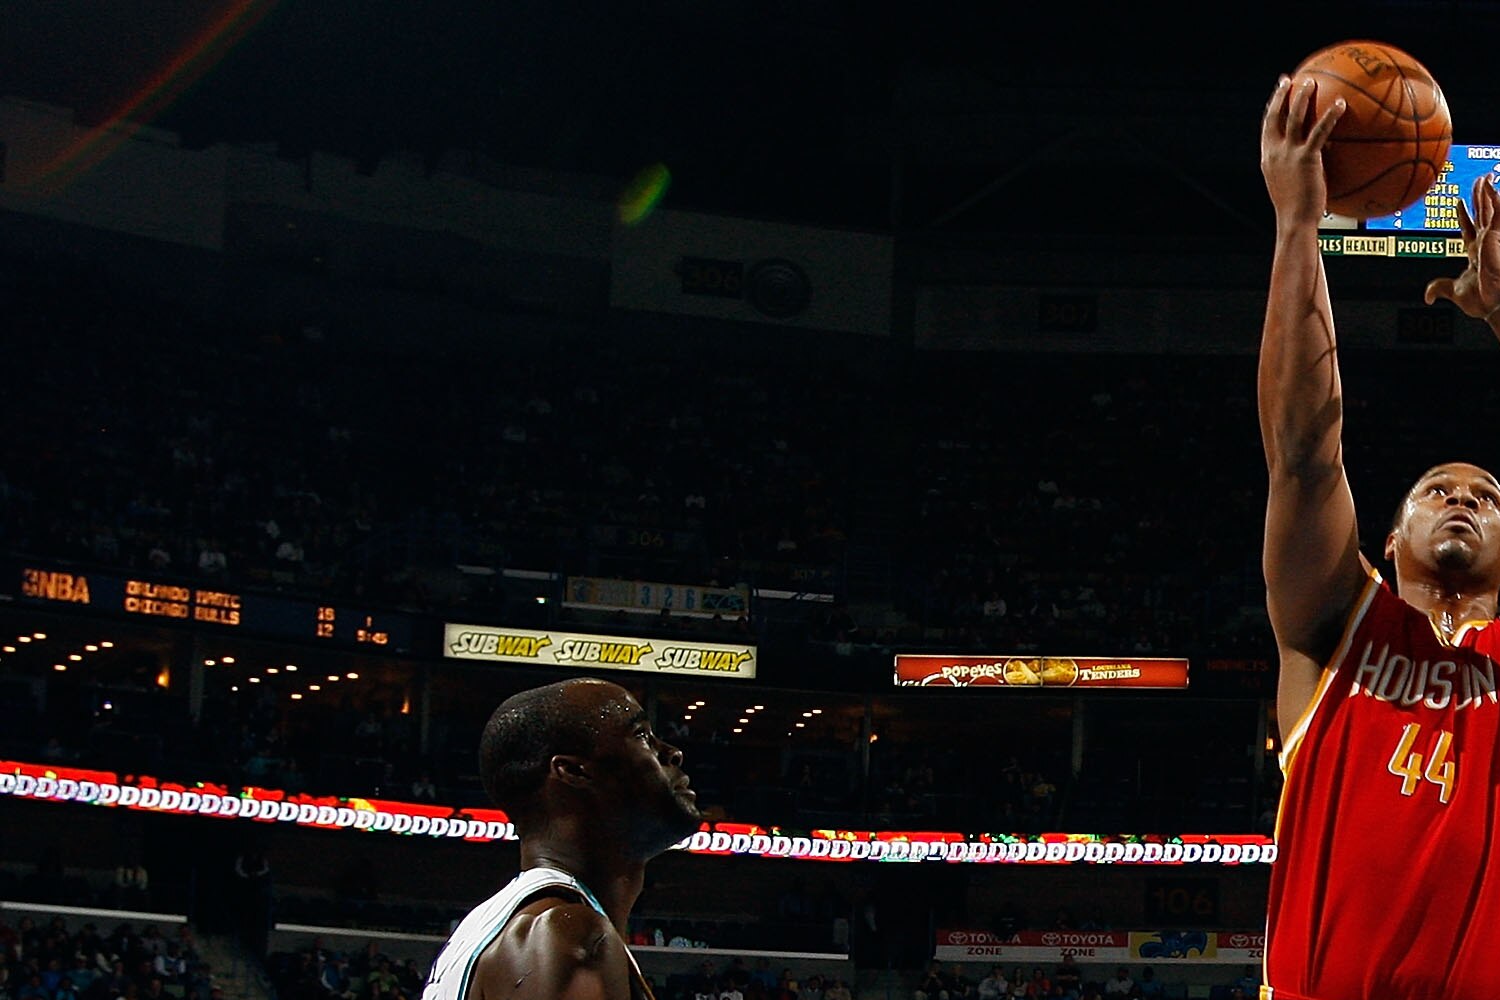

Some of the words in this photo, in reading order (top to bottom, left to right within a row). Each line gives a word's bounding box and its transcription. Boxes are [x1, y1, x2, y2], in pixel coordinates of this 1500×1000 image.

[1344, 242, 1386, 254] HEALTH
[1398, 242, 1444, 254] PEOPLES
[452, 632, 552, 659] SUBWAY
[553, 640, 654, 668] SUBWAY
[655, 648, 753, 673] SUBWAY
[1078, 667, 1140, 681] TENDERS
[1387, 722, 1455, 804] 44
[1060, 933, 1114, 946] TOYOTA
[967, 947, 1002, 957] ZONE
[1060, 947, 1096, 958] ZONE
